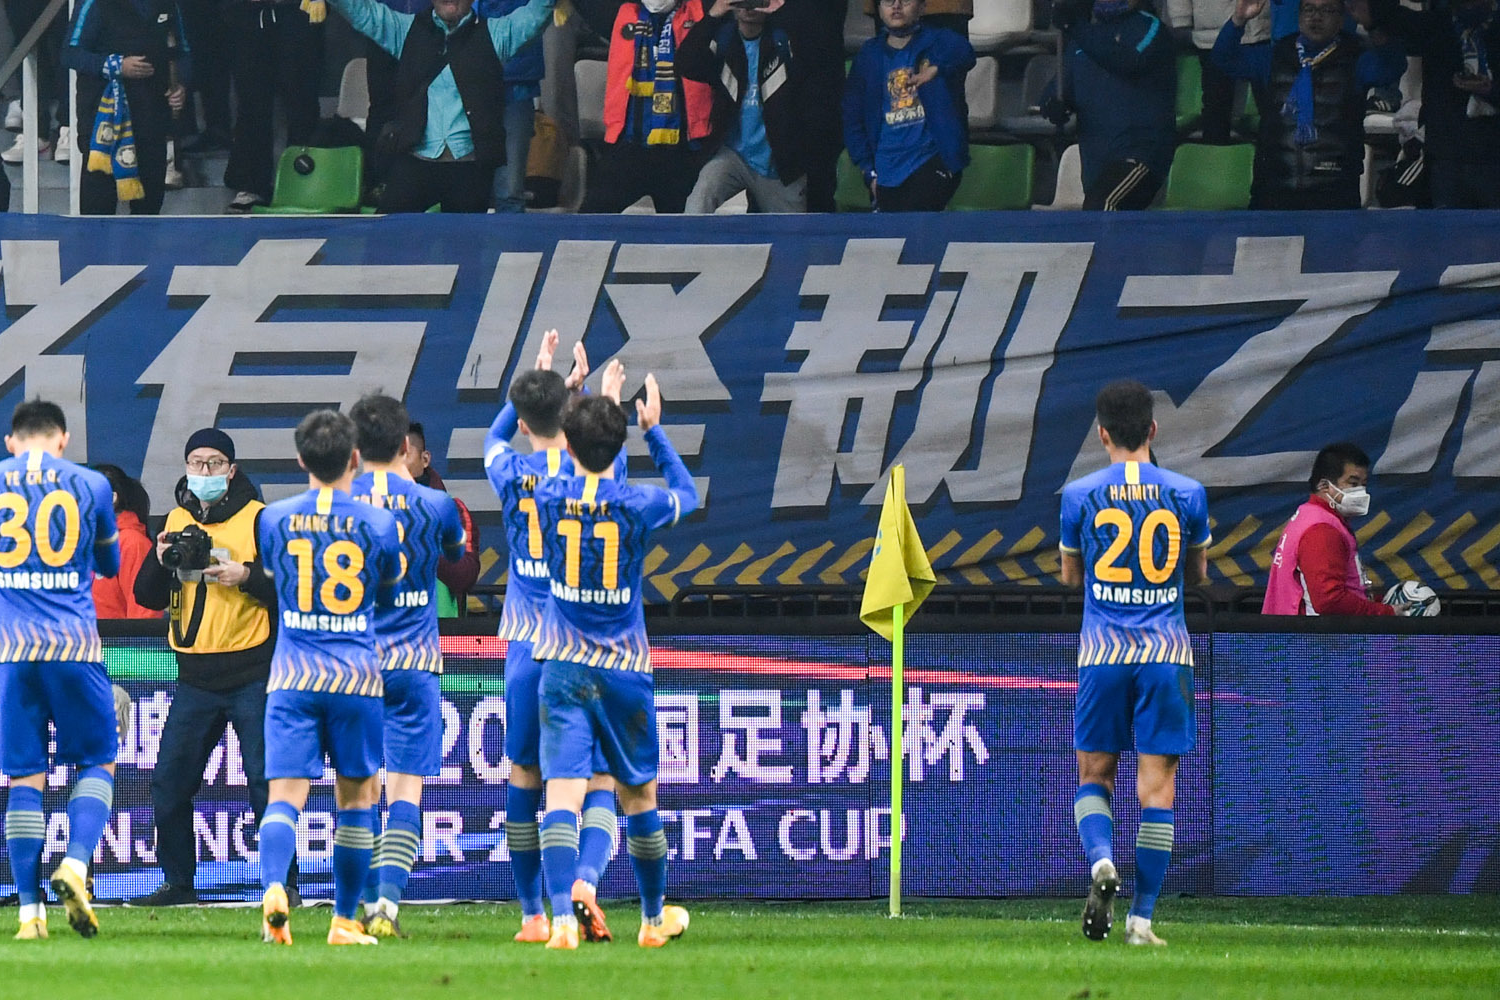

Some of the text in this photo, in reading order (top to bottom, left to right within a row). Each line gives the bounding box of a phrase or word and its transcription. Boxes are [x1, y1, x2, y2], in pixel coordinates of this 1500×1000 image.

[4, 471, 20, 487] YE
[1109, 484, 1160, 501] HAIMITI
[564, 500, 583, 516] XIE
[288, 514, 329, 533] ZHANG
[556, 519, 620, 590] 11
[1093, 507, 1181, 584] 20
[287, 538, 365, 615] 18
[550, 578, 632, 605] SAMSUNG
[1092, 582, 1179, 605] SAMSUNG
[282, 609, 368, 633] SAMSUNG
[778, 807, 906, 861] CUP
